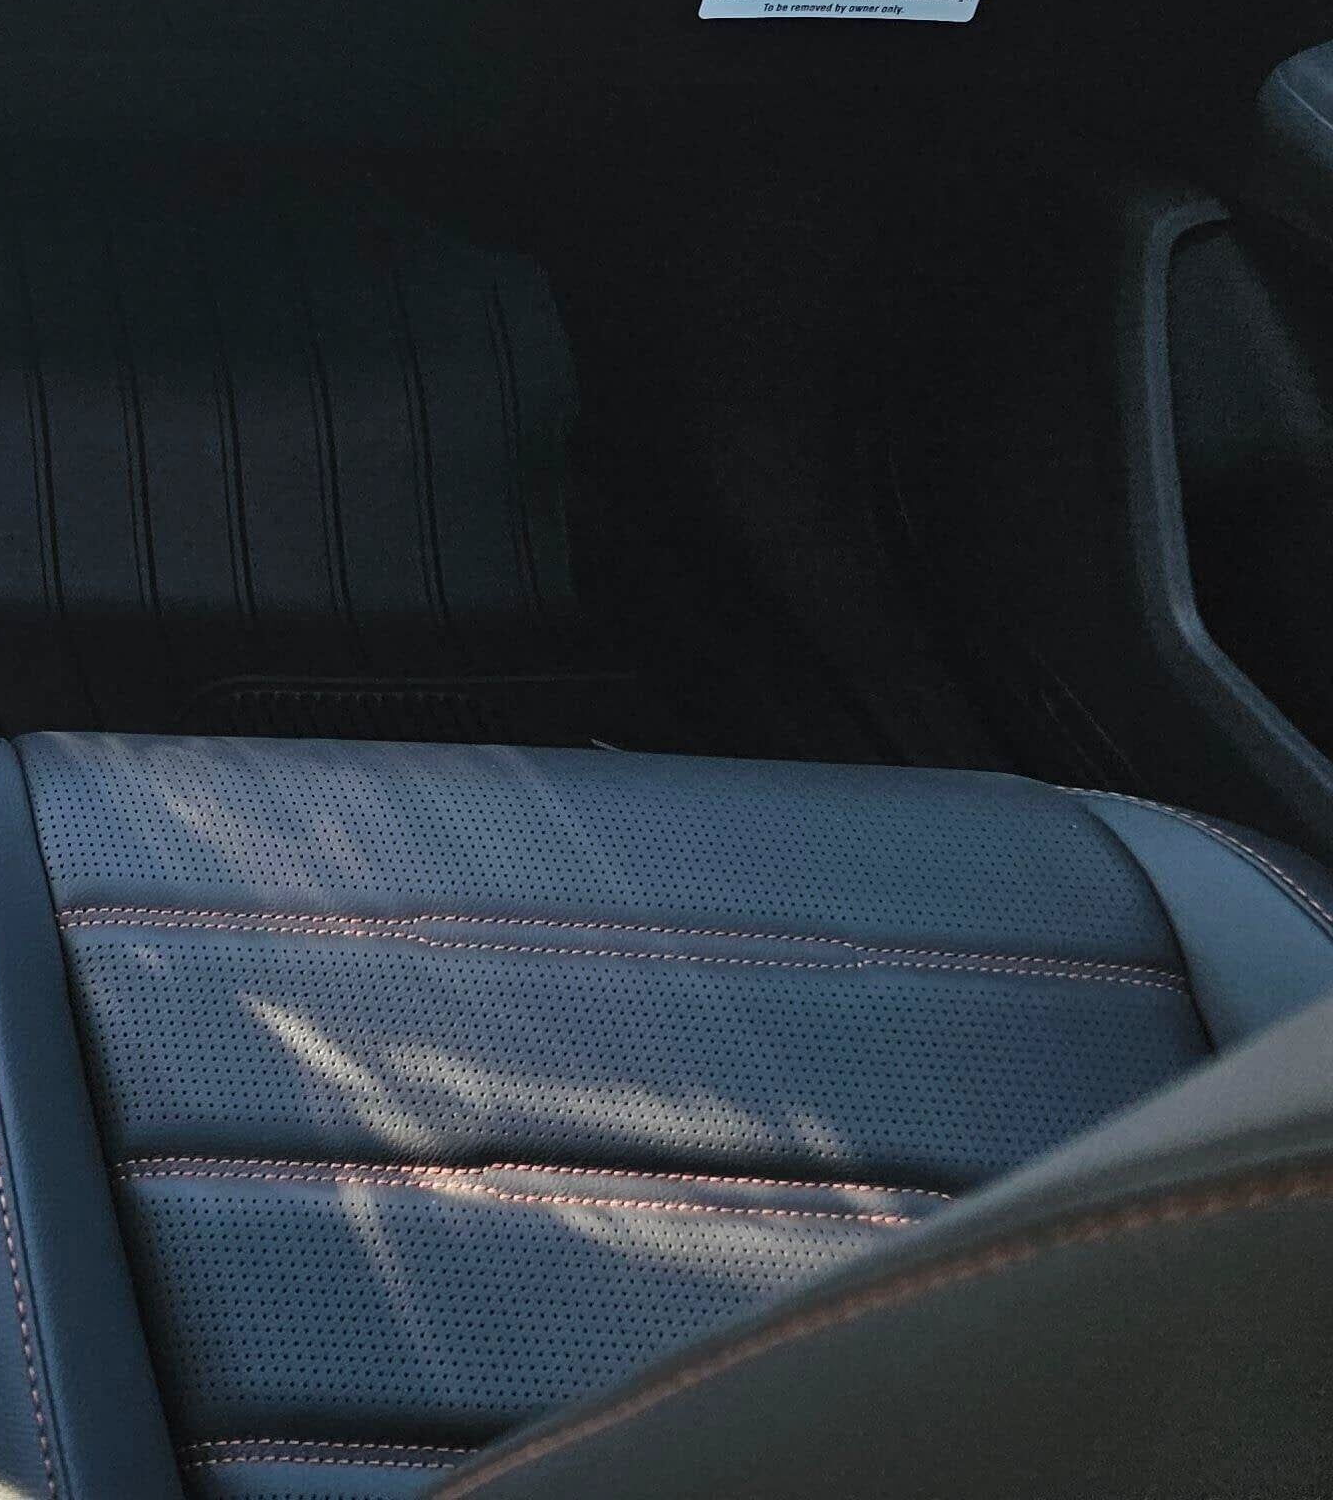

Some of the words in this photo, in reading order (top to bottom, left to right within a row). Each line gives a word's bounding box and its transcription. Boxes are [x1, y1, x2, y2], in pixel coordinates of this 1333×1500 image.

[763, 3, 774, 12] To
[776, 3, 788, 12] be
[790, 3, 833, 12] removed
[835, 4, 847, 14] by
[848, 5, 881, 13] owner
[881, 5, 905, 15] only.
